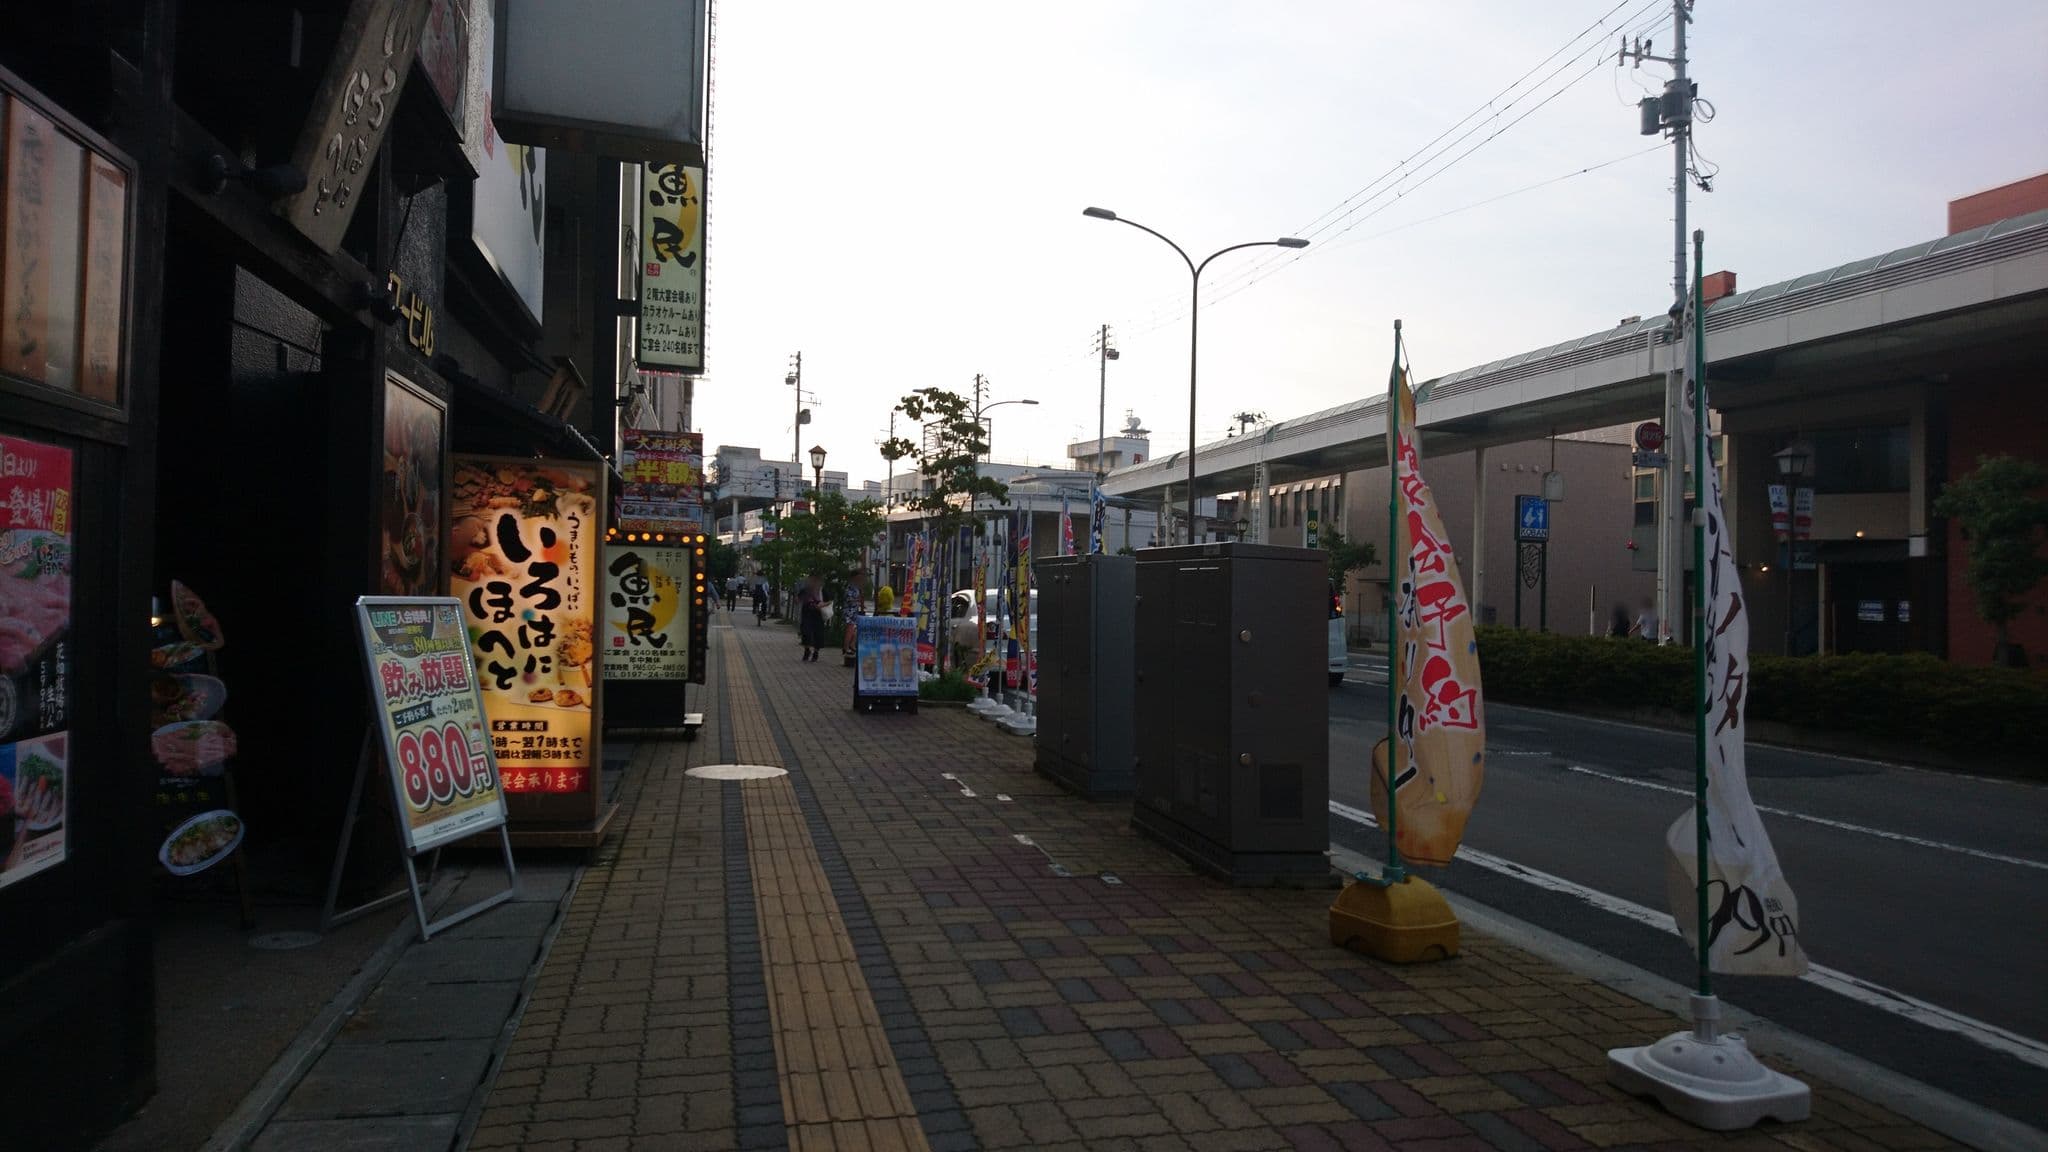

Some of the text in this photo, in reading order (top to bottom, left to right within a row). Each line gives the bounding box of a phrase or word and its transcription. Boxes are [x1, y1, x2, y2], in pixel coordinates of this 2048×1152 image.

[648, 160, 698, 268] 魚民
[642, 306, 700, 321] カラオケルームあり
[645, 324, 697, 339] キッズルームあり
[469, 581, 517, 690] ほへと
[497, 513, 561, 675] いろはに
[608, 551, 668, 648] 魚民
[381, 656, 468, 699] 飲み放題
[397, 723, 492, 811] 880円
